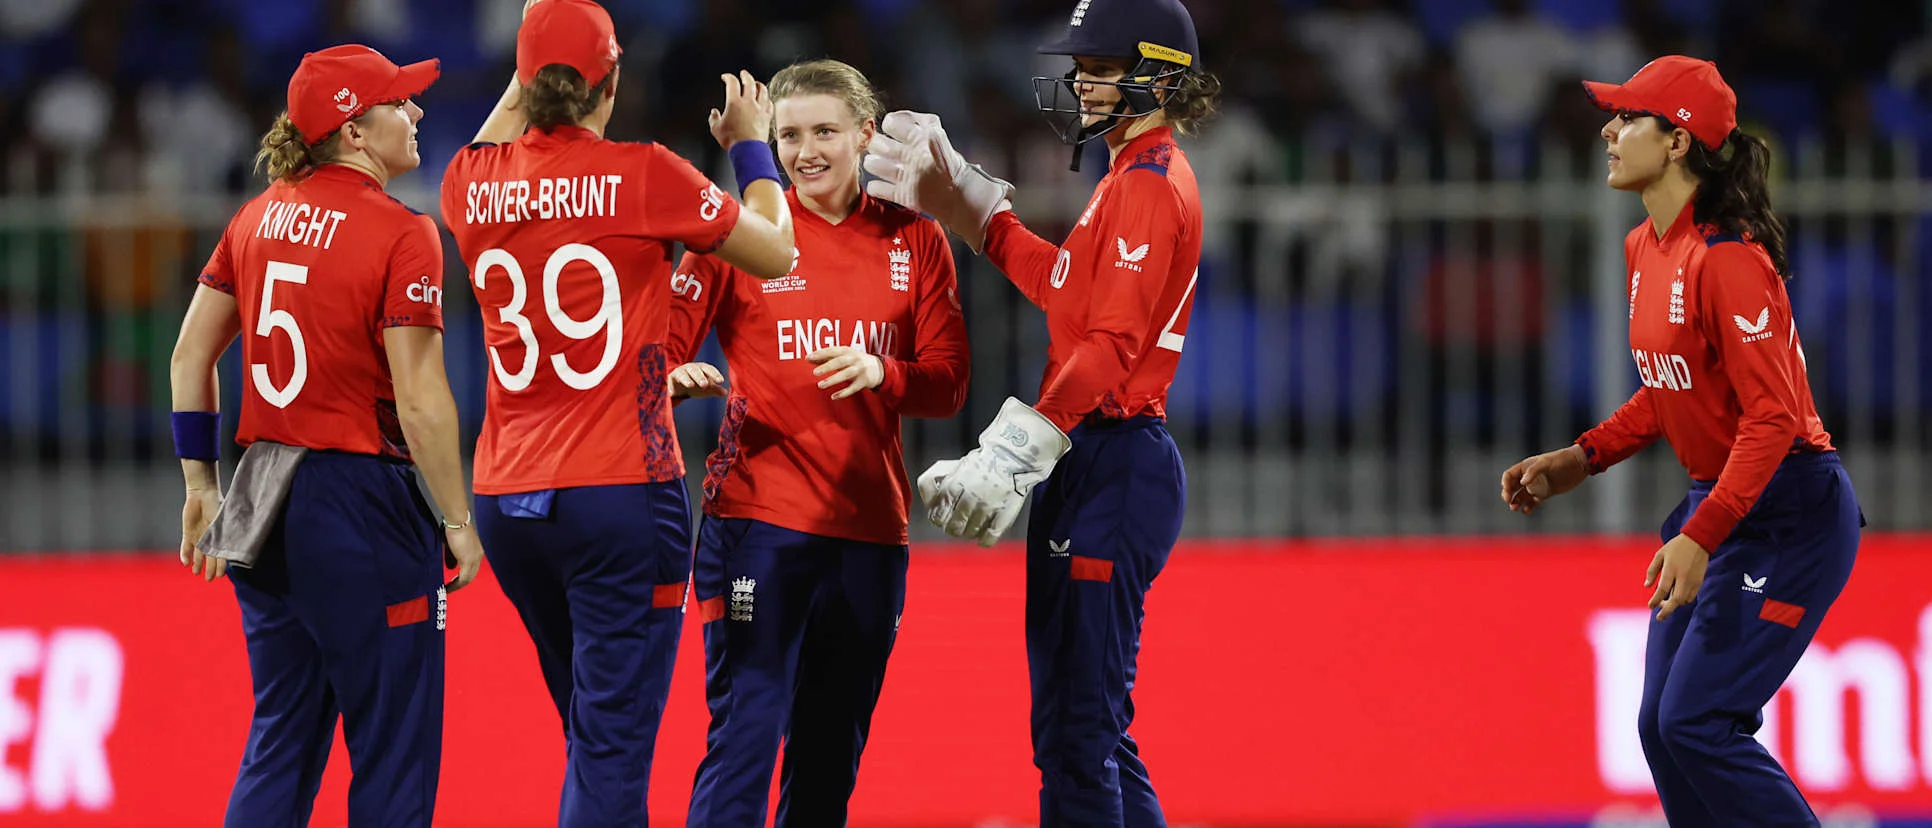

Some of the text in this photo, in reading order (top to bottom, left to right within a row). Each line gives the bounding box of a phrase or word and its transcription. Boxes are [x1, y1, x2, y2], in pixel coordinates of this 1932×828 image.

[333, 87, 350, 103] 100
[1676, 107, 1692, 122] 52
[465, 174, 622, 225] SCIVER-BRUNT
[255, 199, 347, 250] KNIGHT
[406, 275, 443, 309] cin
[761, 280, 790, 289] WORLD
[251, 260, 309, 409] 5
[474, 243, 623, 392] 39
